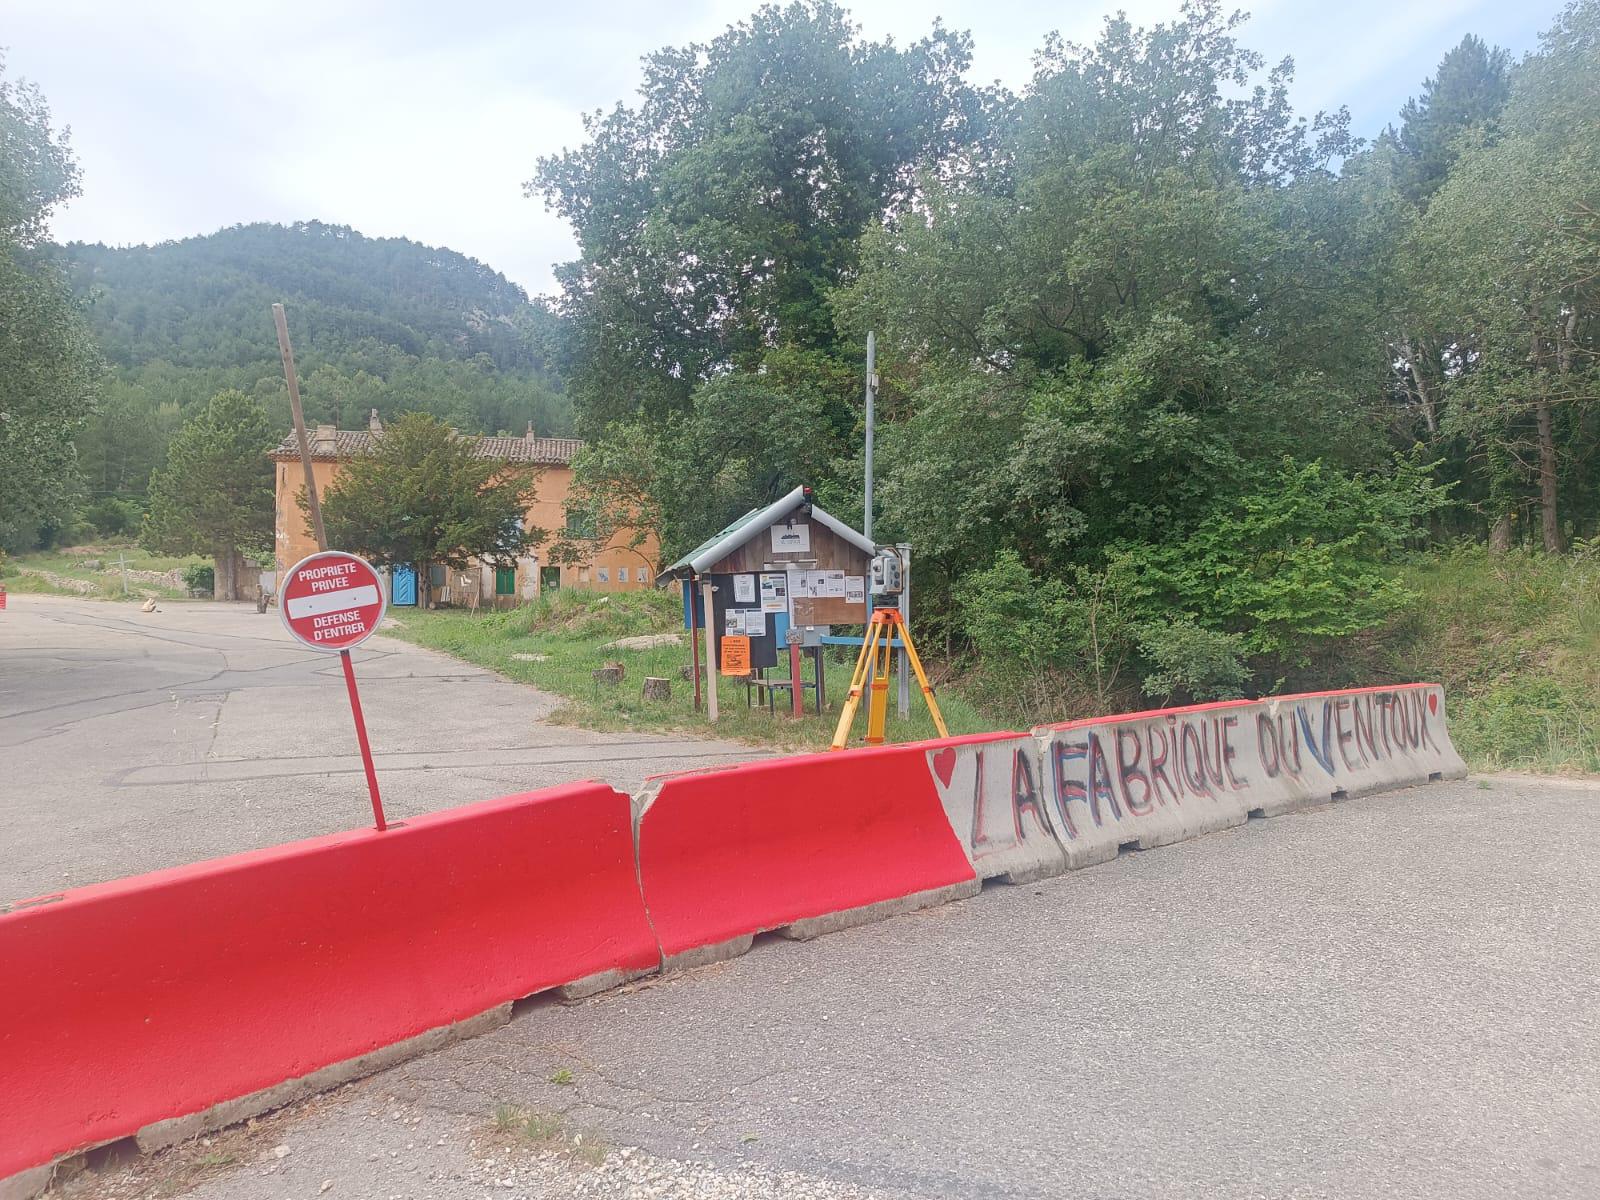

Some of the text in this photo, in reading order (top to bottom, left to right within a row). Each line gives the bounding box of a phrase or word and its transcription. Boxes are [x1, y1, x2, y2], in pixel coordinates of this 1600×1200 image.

[298, 562, 357, 582] PROPRIETE
[311, 576, 350, 593] PRIVEE
[313, 610, 361, 628] DEFENSE
[313, 622, 365, 641] D'ENTRER
[970, 748, 1052, 862] LA
[1255, 709, 1302, 782] DU
[1296, 688, 1441, 777] VENTOUX
